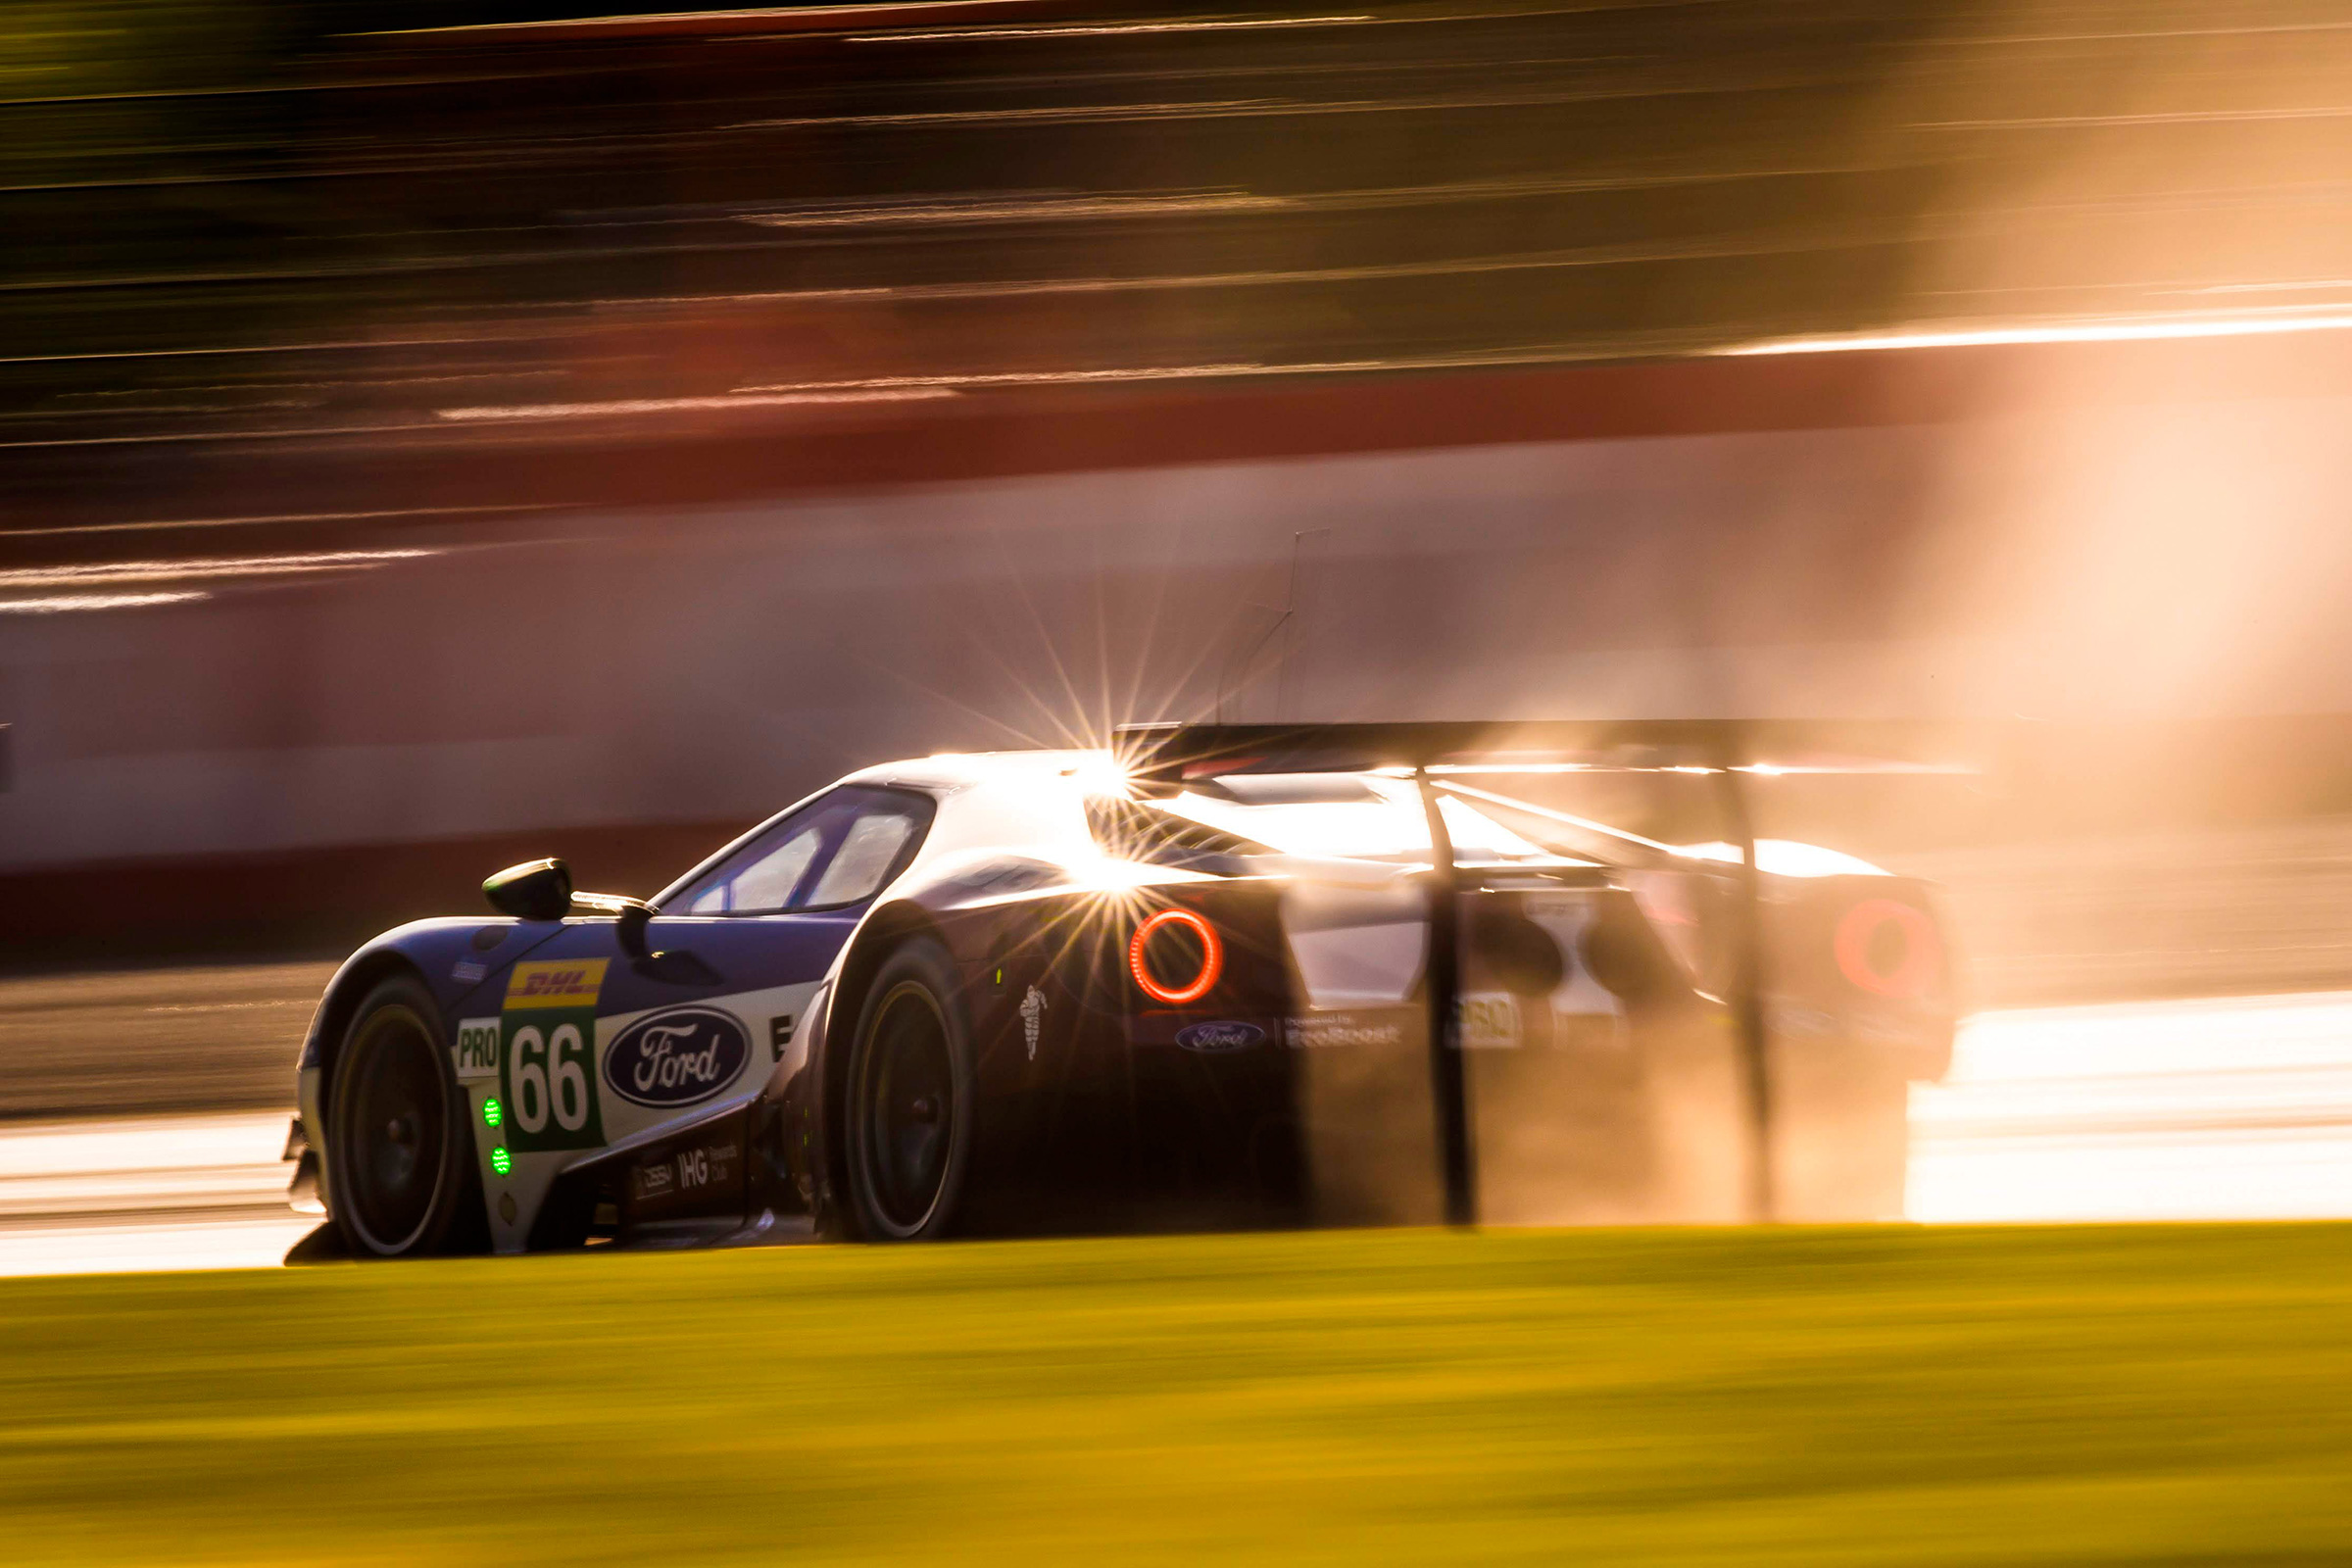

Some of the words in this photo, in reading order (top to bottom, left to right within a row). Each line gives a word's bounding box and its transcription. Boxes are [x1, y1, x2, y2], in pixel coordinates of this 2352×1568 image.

[518, 969, 590, 996] DHL
[459, 1027, 497, 1068] PRO
[1192, 1024, 1249, 1048] Ford
[633, 1023, 720, 1092] Ford
[509, 1023, 588, 1134] 66
[676, 1149, 708, 1190] IHG
